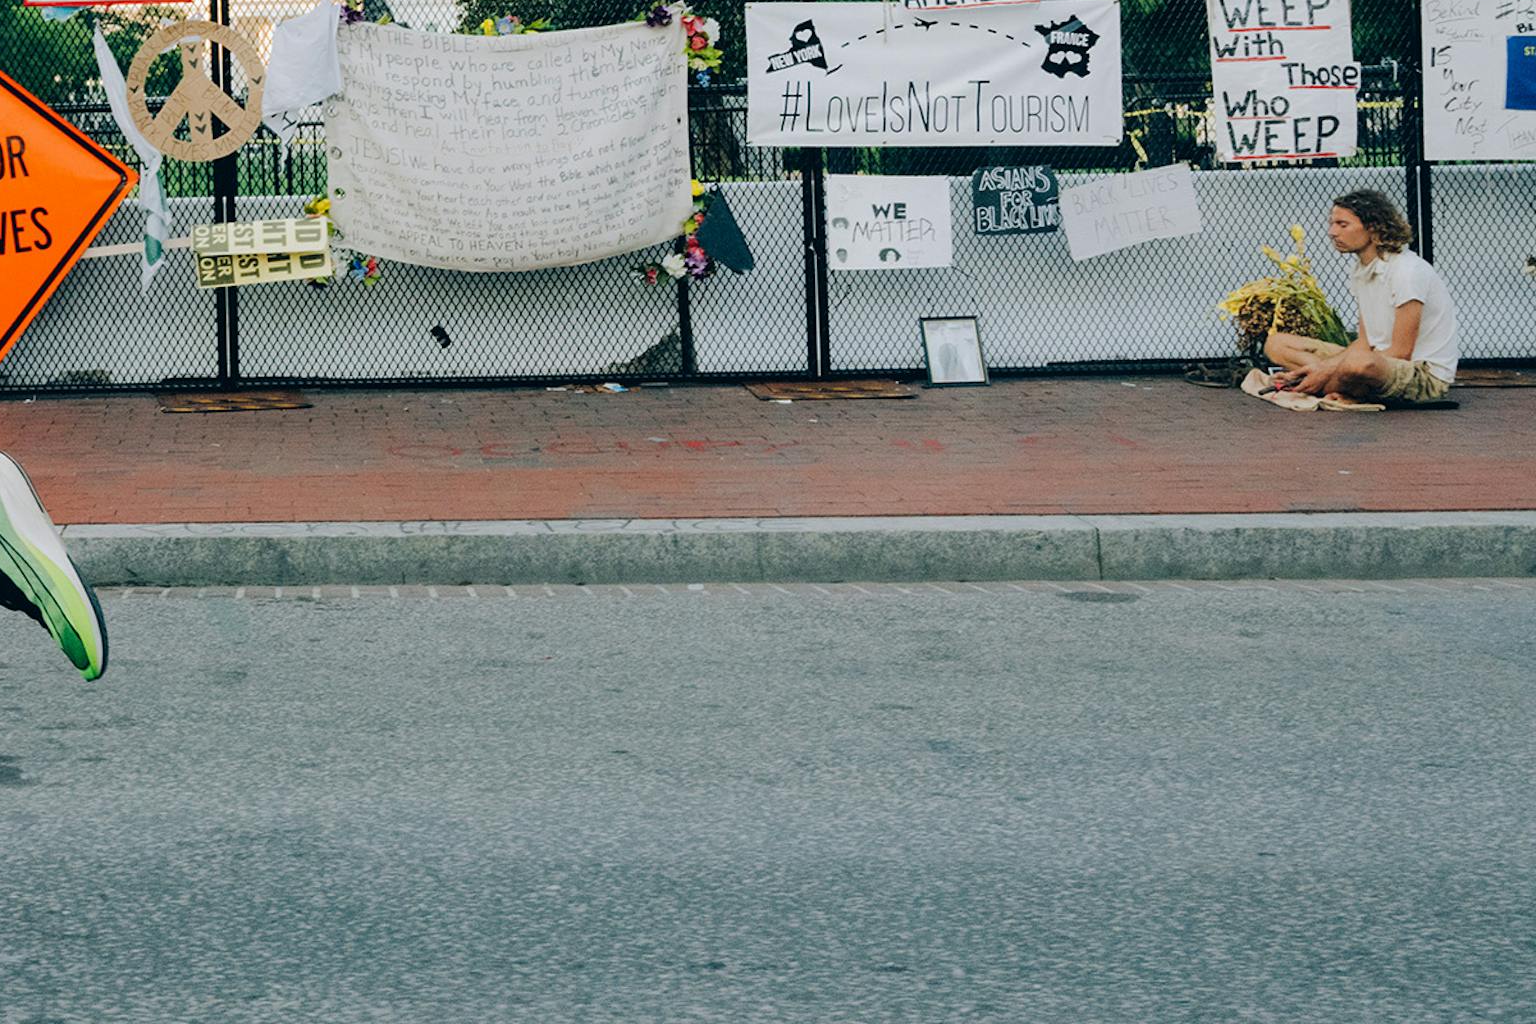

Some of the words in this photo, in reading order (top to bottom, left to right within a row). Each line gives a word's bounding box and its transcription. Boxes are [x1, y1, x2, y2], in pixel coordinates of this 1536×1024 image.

[384, 29, 415, 48] THE
[421, 33, 481, 54] BIBLE:
[1049, 29, 1090, 47] FRANCE
[1213, 31, 1284, 58] With
[385, 53, 441, 75] people
[449, 55, 490, 74] who
[527, 46, 573, 70] called
[581, 47, 598, 68] by
[599, 42, 625, 67] My
[629, 35, 668, 54] Name
[770, 53, 794, 70] NEW
[792, 45, 822, 63] YORK
[383, 70, 457, 90] respond
[462, 72, 482, 97] by
[490, 70, 563, 93] humbling
[1280, 63, 1359, 87] Those
[480, 91, 521, 112] face
[526, 88, 564, 107] and
[1223, 89, 1290, 117] Who
[417, 104, 434, 121] I
[438, 106, 469, 123] will
[446, 122, 497, 142] their
[1226, 115, 1340, 155] WEEP
[978, 165, 1051, 193] ASIANS
[1000, 189, 1034, 207] FOR
[1071, 185, 1119, 216] BLACK
[1128, 172, 1179, 199] LIVES
[871, 202, 907, 220] WE
[976, 205, 1029, 233] BLACK
[851, 217, 937, 244] MATTER
[1094, 205, 1177, 244] MATTER
[447, 236, 464, 251] TO
[468, 238, 524, 252] HEAVEN
